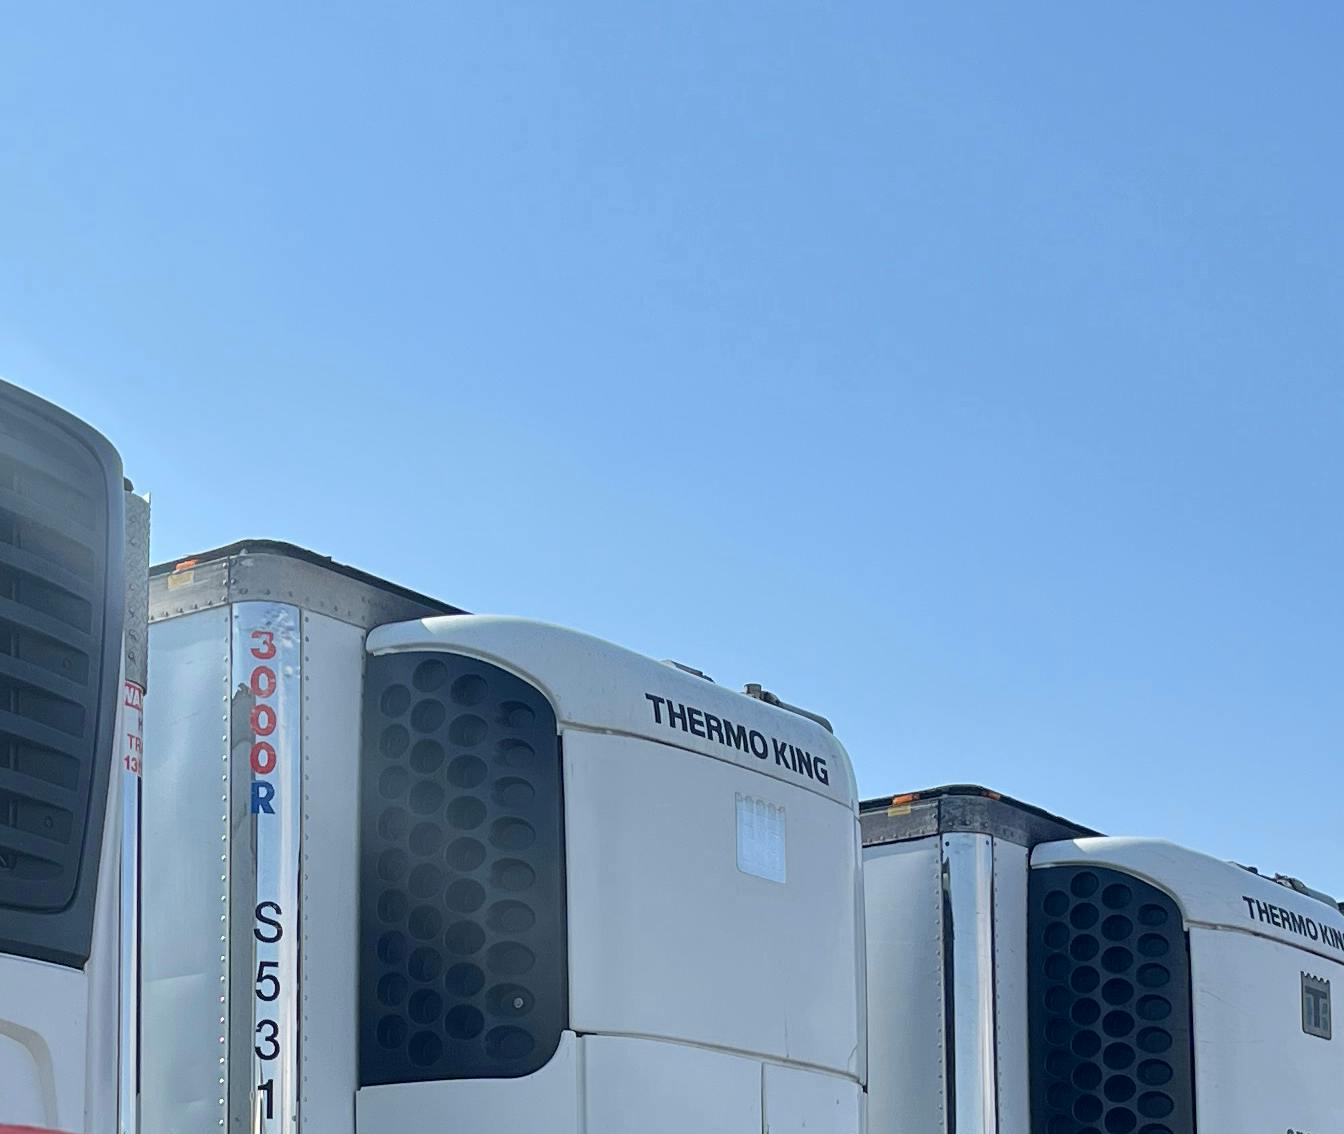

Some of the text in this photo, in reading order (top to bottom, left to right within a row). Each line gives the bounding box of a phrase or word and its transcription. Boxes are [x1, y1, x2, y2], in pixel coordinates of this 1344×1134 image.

[249, 630, 277, 815] 3000R
[645, 693, 830, 786] THERMO KING
[1242, 895, 1318, 942] THERMO
